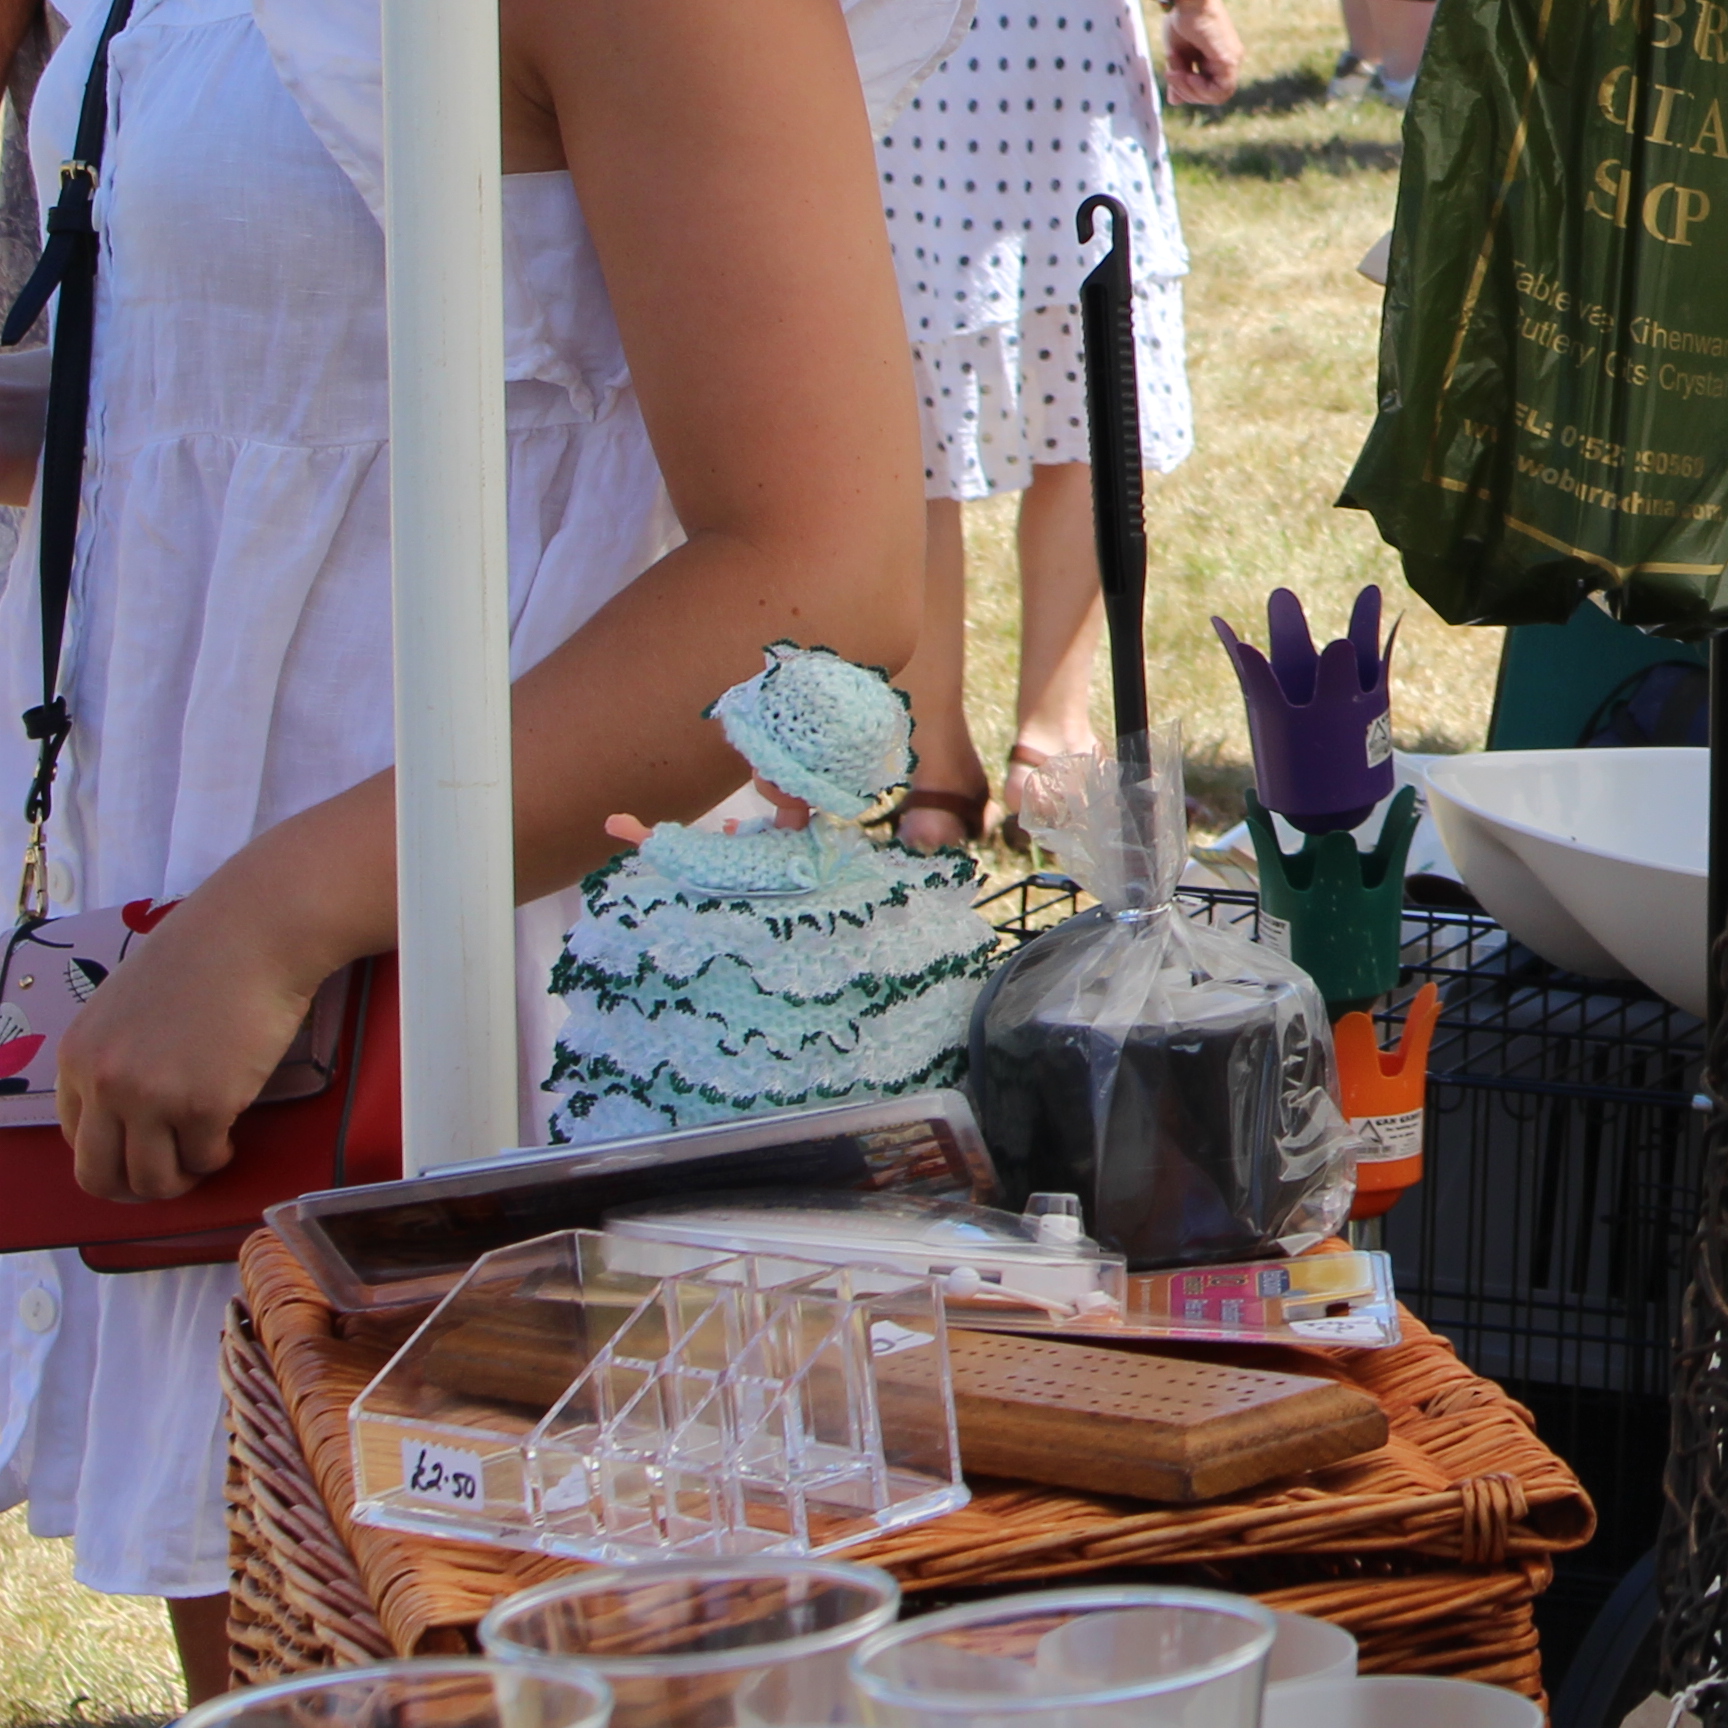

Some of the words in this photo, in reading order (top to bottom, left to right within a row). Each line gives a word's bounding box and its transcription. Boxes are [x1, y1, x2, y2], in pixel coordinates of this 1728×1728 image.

[1518, 306, 1596, 368] utlery
[1514, 402, 1554, 439] EL:
[411, 1449, 476, 1499] £2.50
